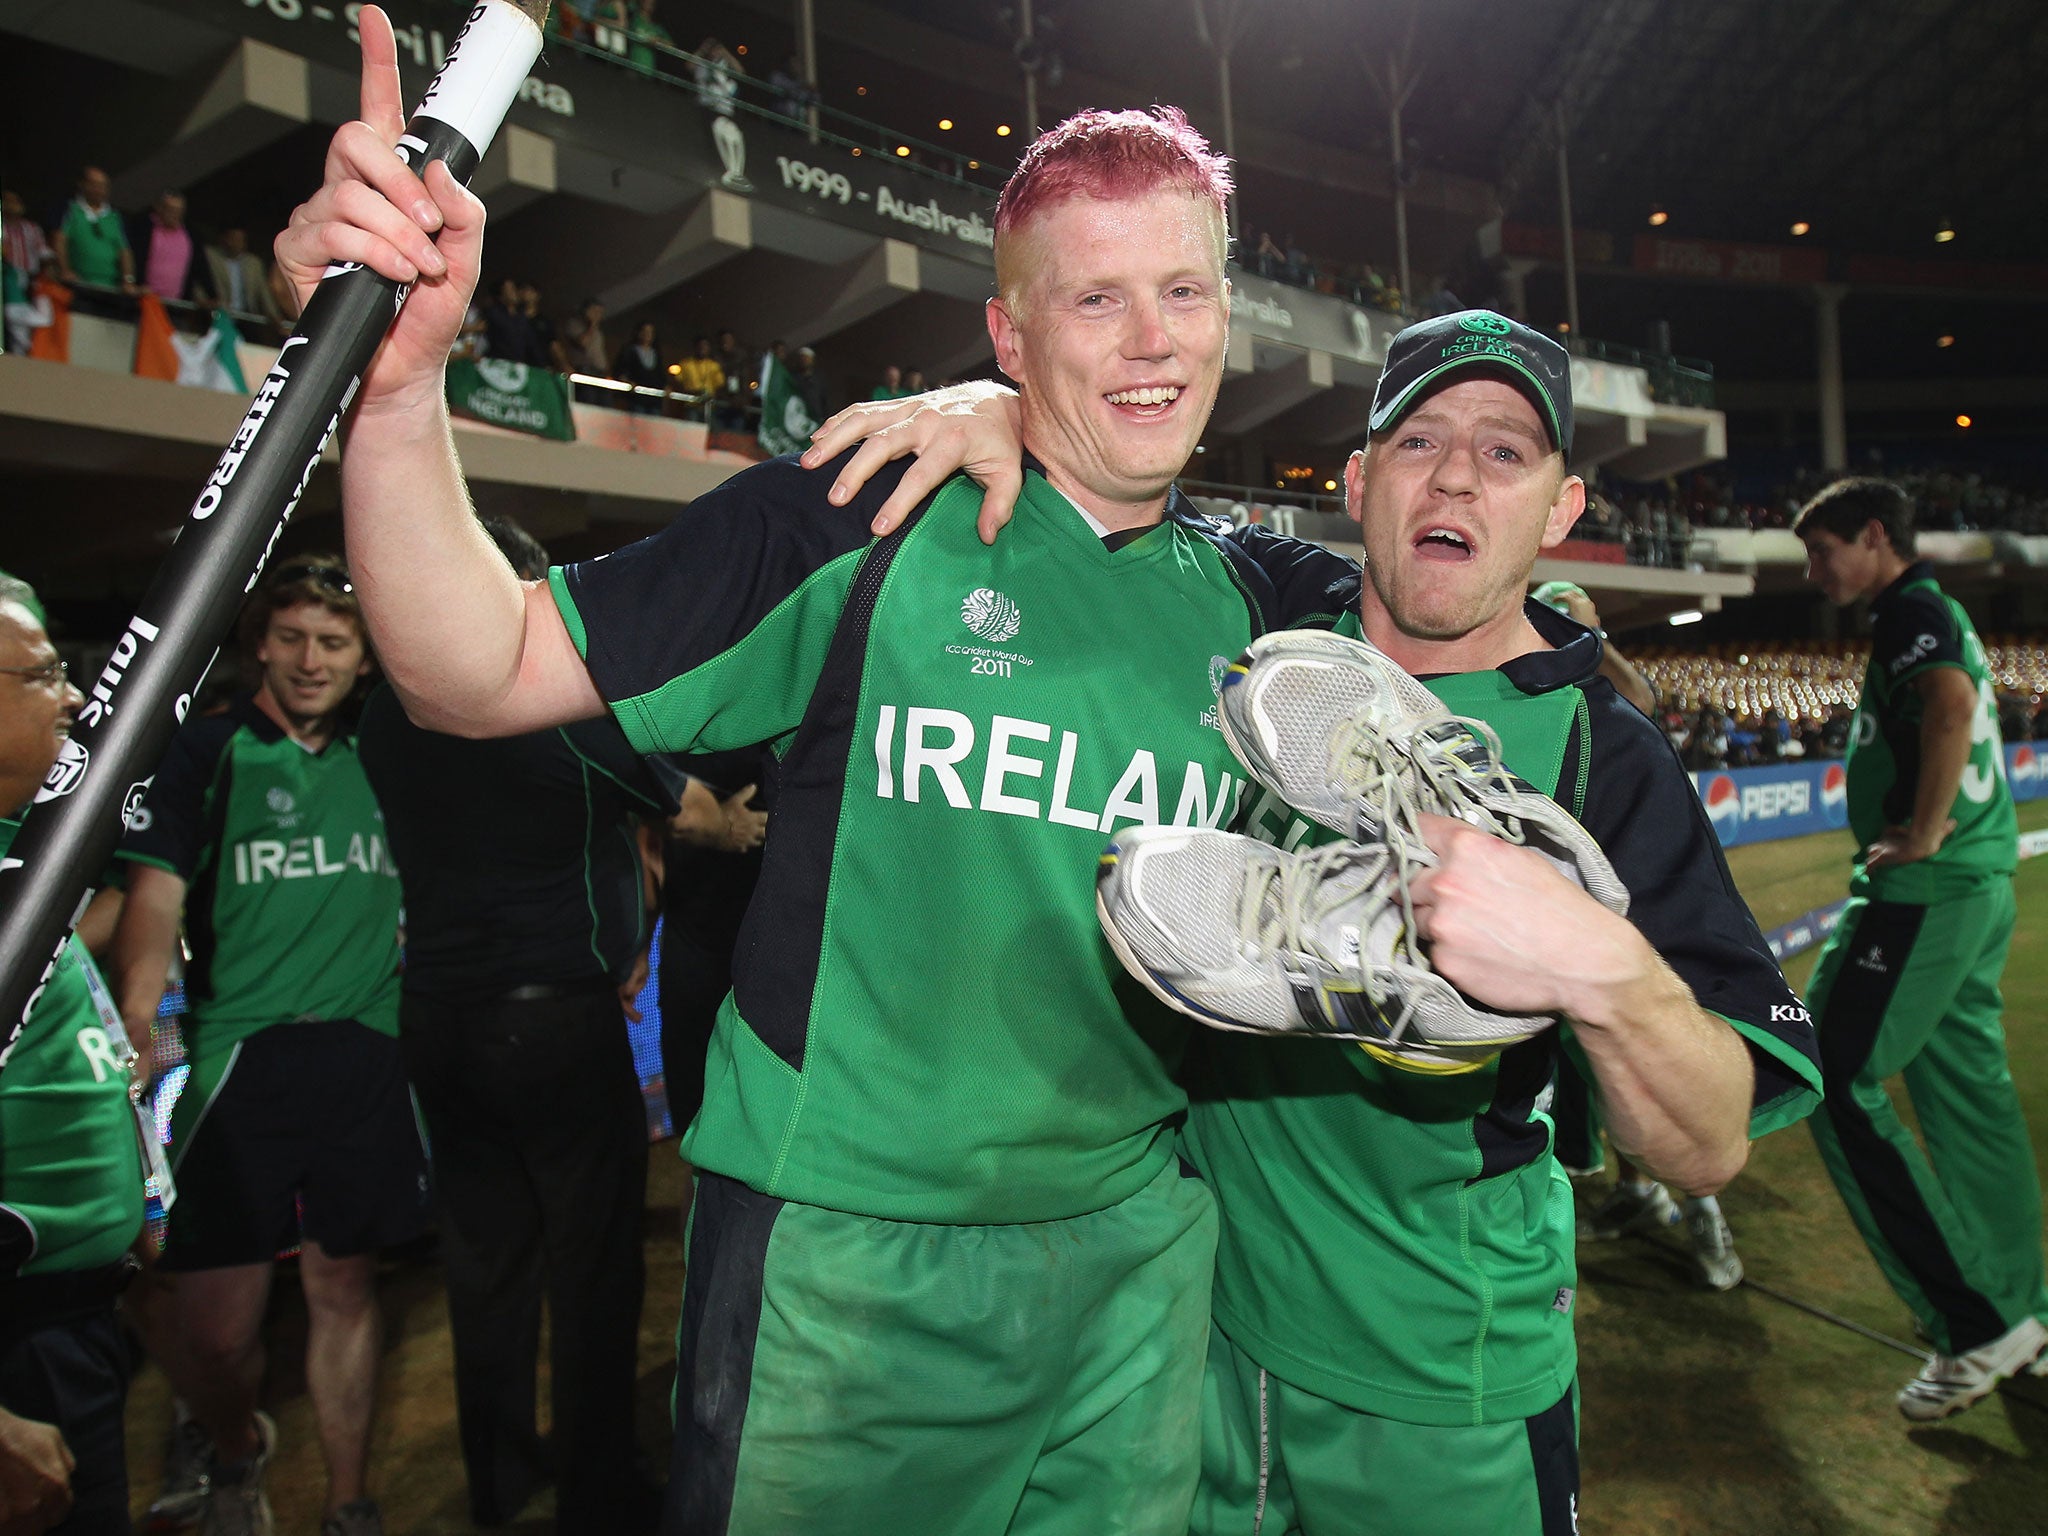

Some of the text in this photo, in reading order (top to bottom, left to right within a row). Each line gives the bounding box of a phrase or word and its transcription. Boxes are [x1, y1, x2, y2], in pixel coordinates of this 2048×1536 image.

[777, 156, 852, 205] 1999
[192, 376, 288, 521] HERO
[945, 644, 961, 654] ICC
[992, 649, 1018, 662] World
[1018, 653, 1034, 667] Cup
[970, 656, 1012, 679] 2011
[875, 704, 1248, 835] IRELAN
[1741, 780, 1811, 823] PEPSI
